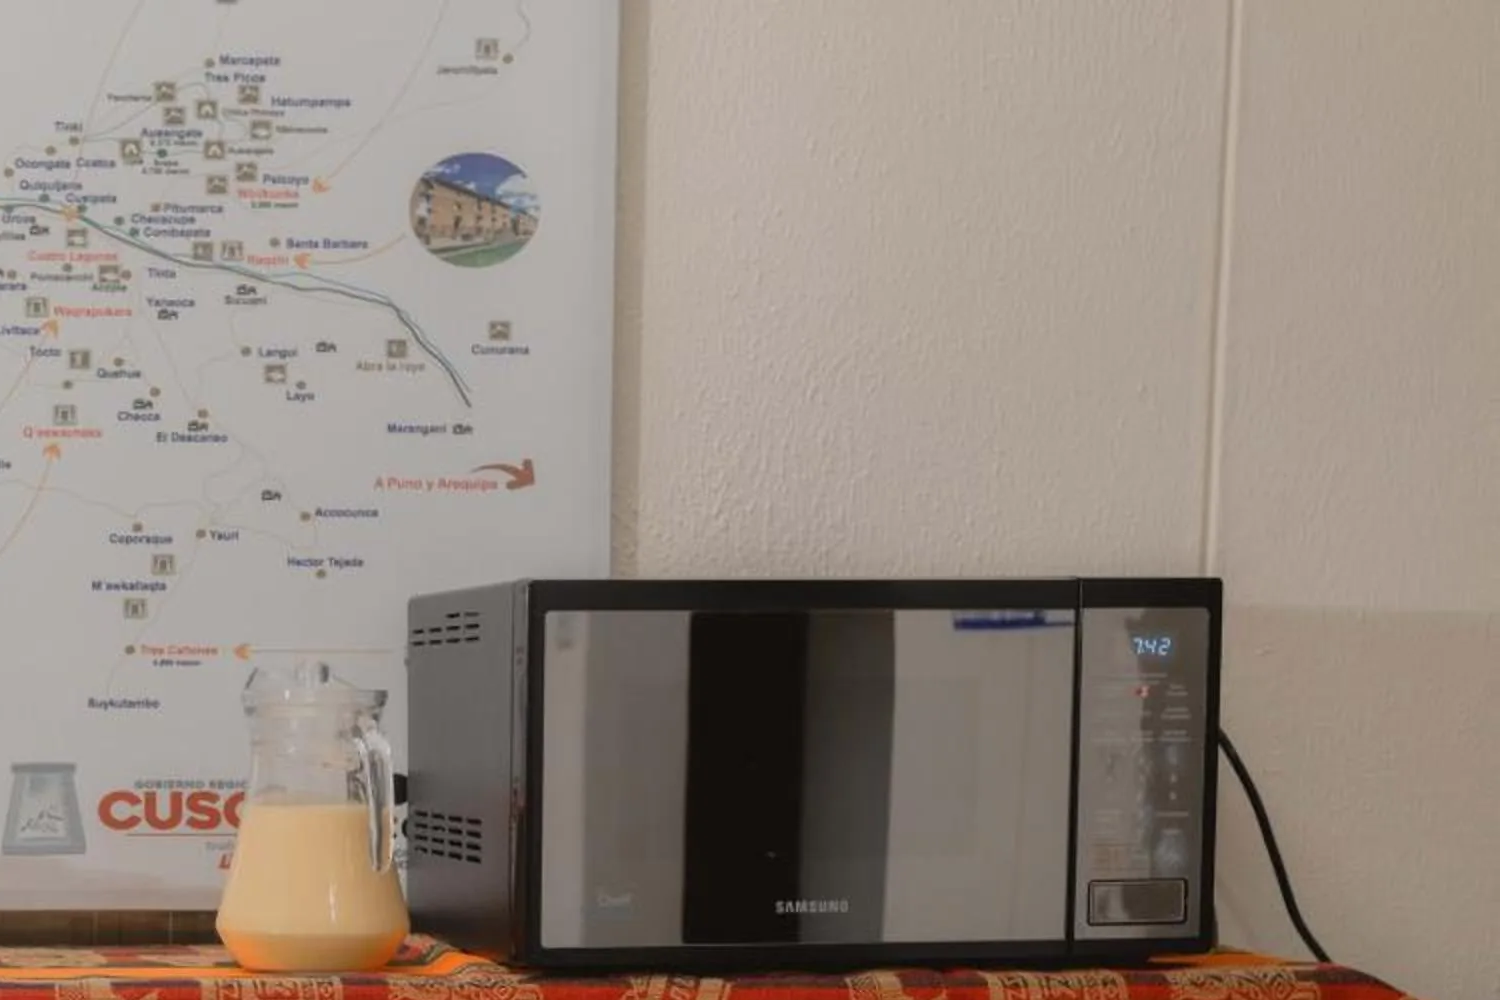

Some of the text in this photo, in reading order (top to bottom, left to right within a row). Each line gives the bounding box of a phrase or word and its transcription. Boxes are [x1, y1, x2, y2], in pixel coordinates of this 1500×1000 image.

[374, 478, 498, 492] A Puno y Arequipa
[775, 899, 849, 914] SAMSUNG
